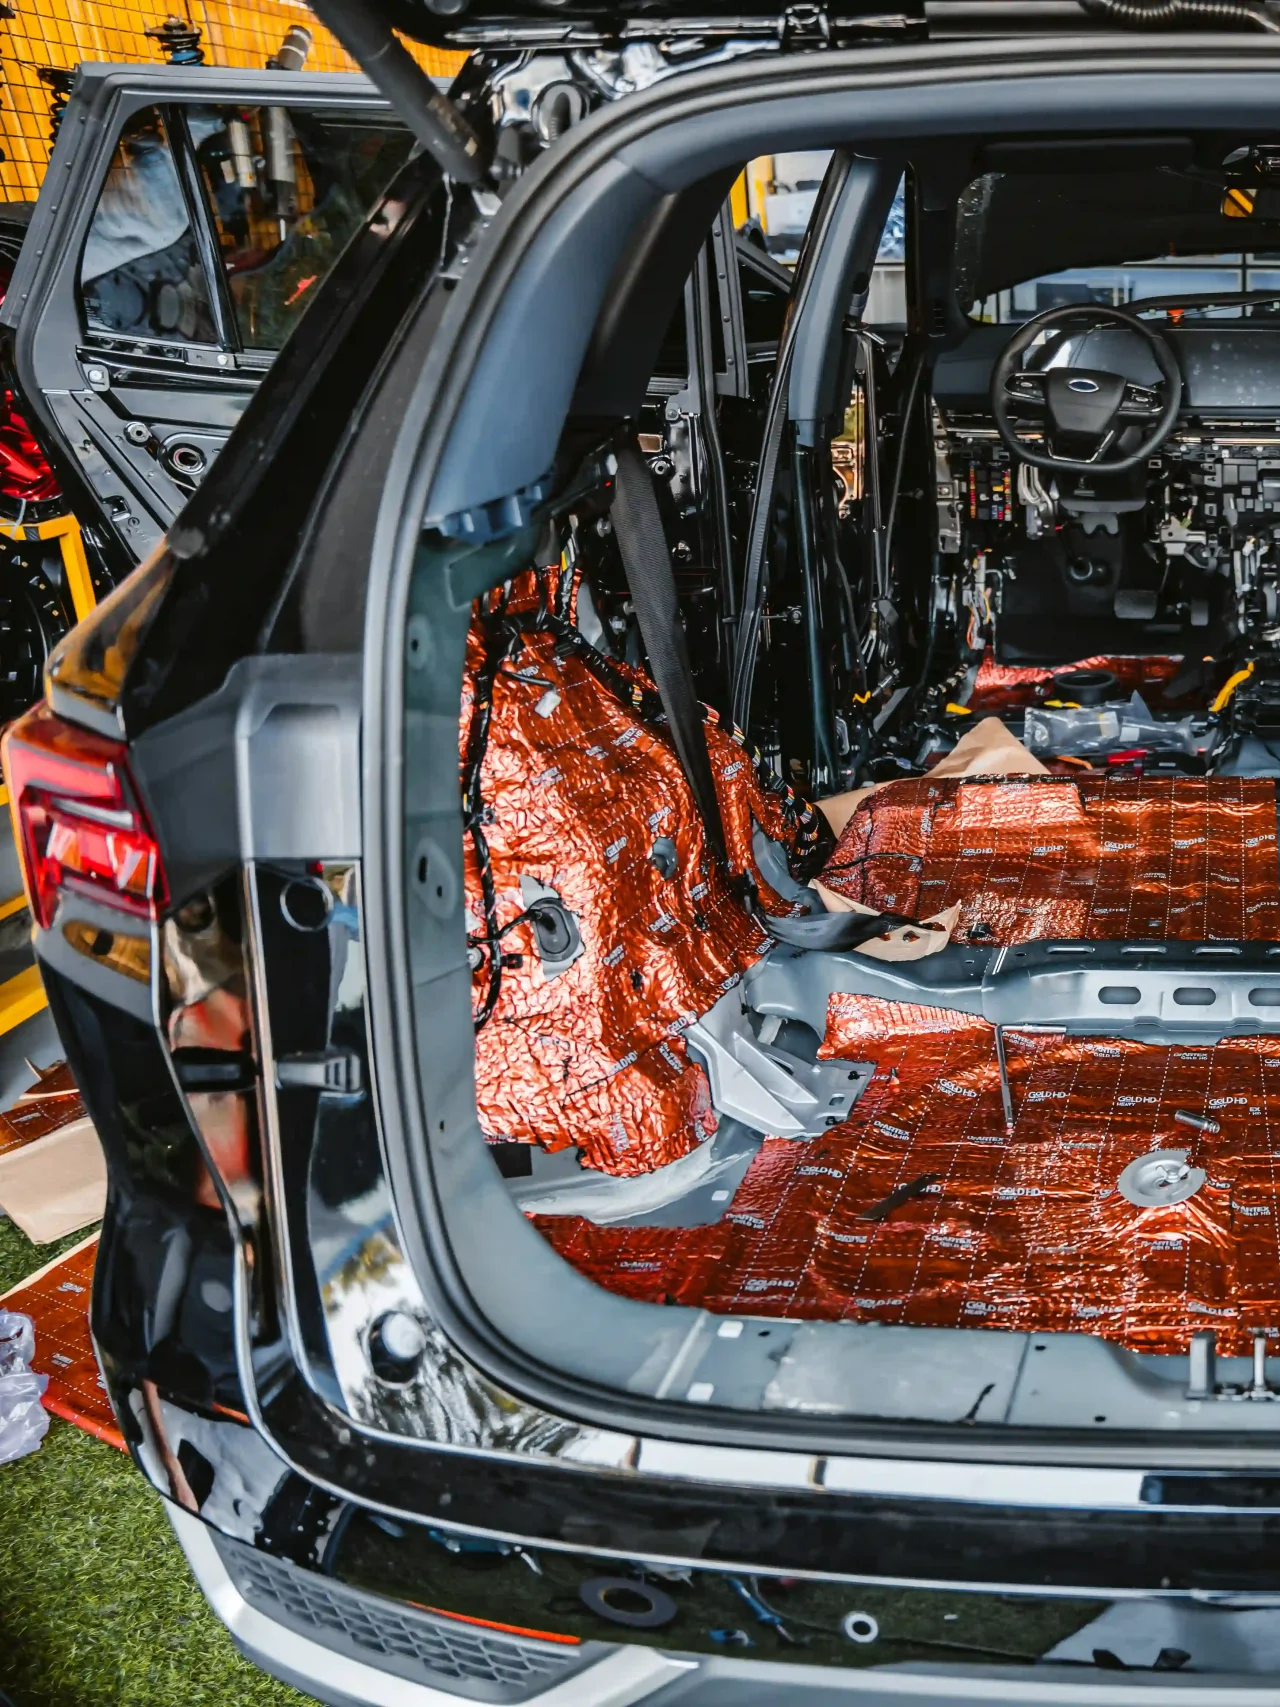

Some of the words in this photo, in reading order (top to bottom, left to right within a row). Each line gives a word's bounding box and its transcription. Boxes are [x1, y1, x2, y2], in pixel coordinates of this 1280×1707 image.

[1174, 838, 1194, 847] GOLD
[938, 1078, 963, 1095] GOLD
[962, 1087, 978, 1099] HD
[1027, 1091, 1053, 1100] GOLD
[1052, 1091, 1068, 1099] HD
[1117, 1095, 1143, 1104] GOLD
[1142, 1096, 1158, 1104] HD
[1208, 1096, 1234, 1106] GOLD
[1233, 1097, 1248, 1105] HD
[799, 1165, 828, 1176] GOLD
[827, 1167, 844, 1179] HD
[925, 1184, 942, 1193] HD
[997, 1186, 1025, 1196] GOLD
[1024, 1187, 1042, 1196] HD
